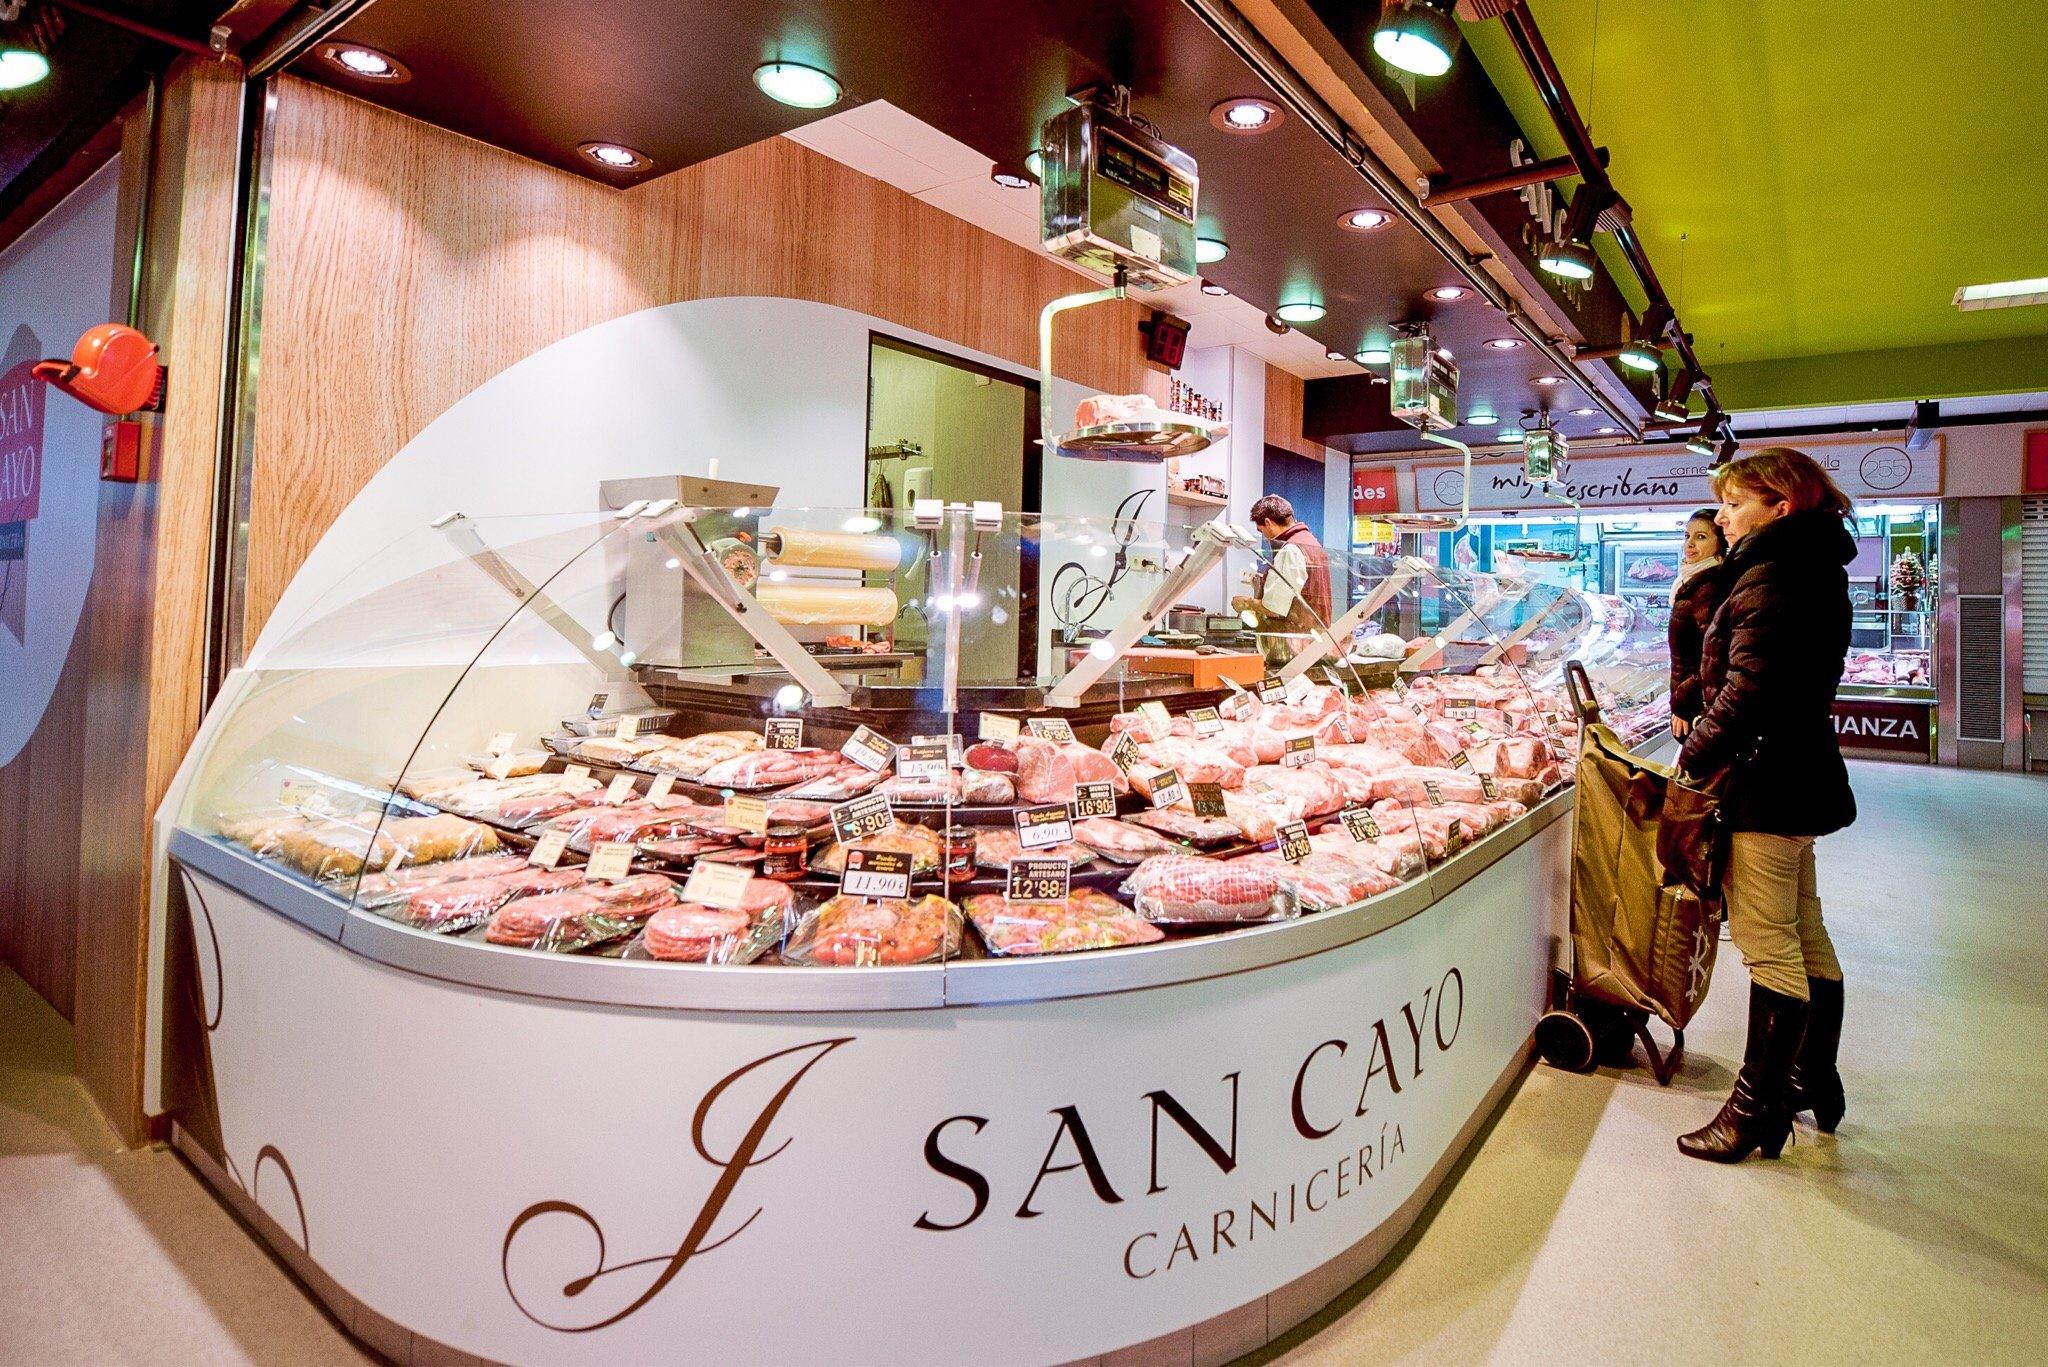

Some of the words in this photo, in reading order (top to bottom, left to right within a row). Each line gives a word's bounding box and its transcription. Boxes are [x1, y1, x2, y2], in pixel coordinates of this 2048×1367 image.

[0, 446, 35, 499] AYO
[1865, 459, 1907, 478] 255
[1566, 468, 1678, 500] escribano
[1829, 714, 1919, 739] IANZA
[848, 796, 884, 812] PRODUCTO
[1079, 799, 1111, 816] 16'90
[1028, 870, 1066, 878] ARTESANO
[912, 1070, 1242, 1232] SAN
[1291, 967, 1464, 1140] CAYO
[1122, 1121, 1406, 1280] CARNICERÍA
